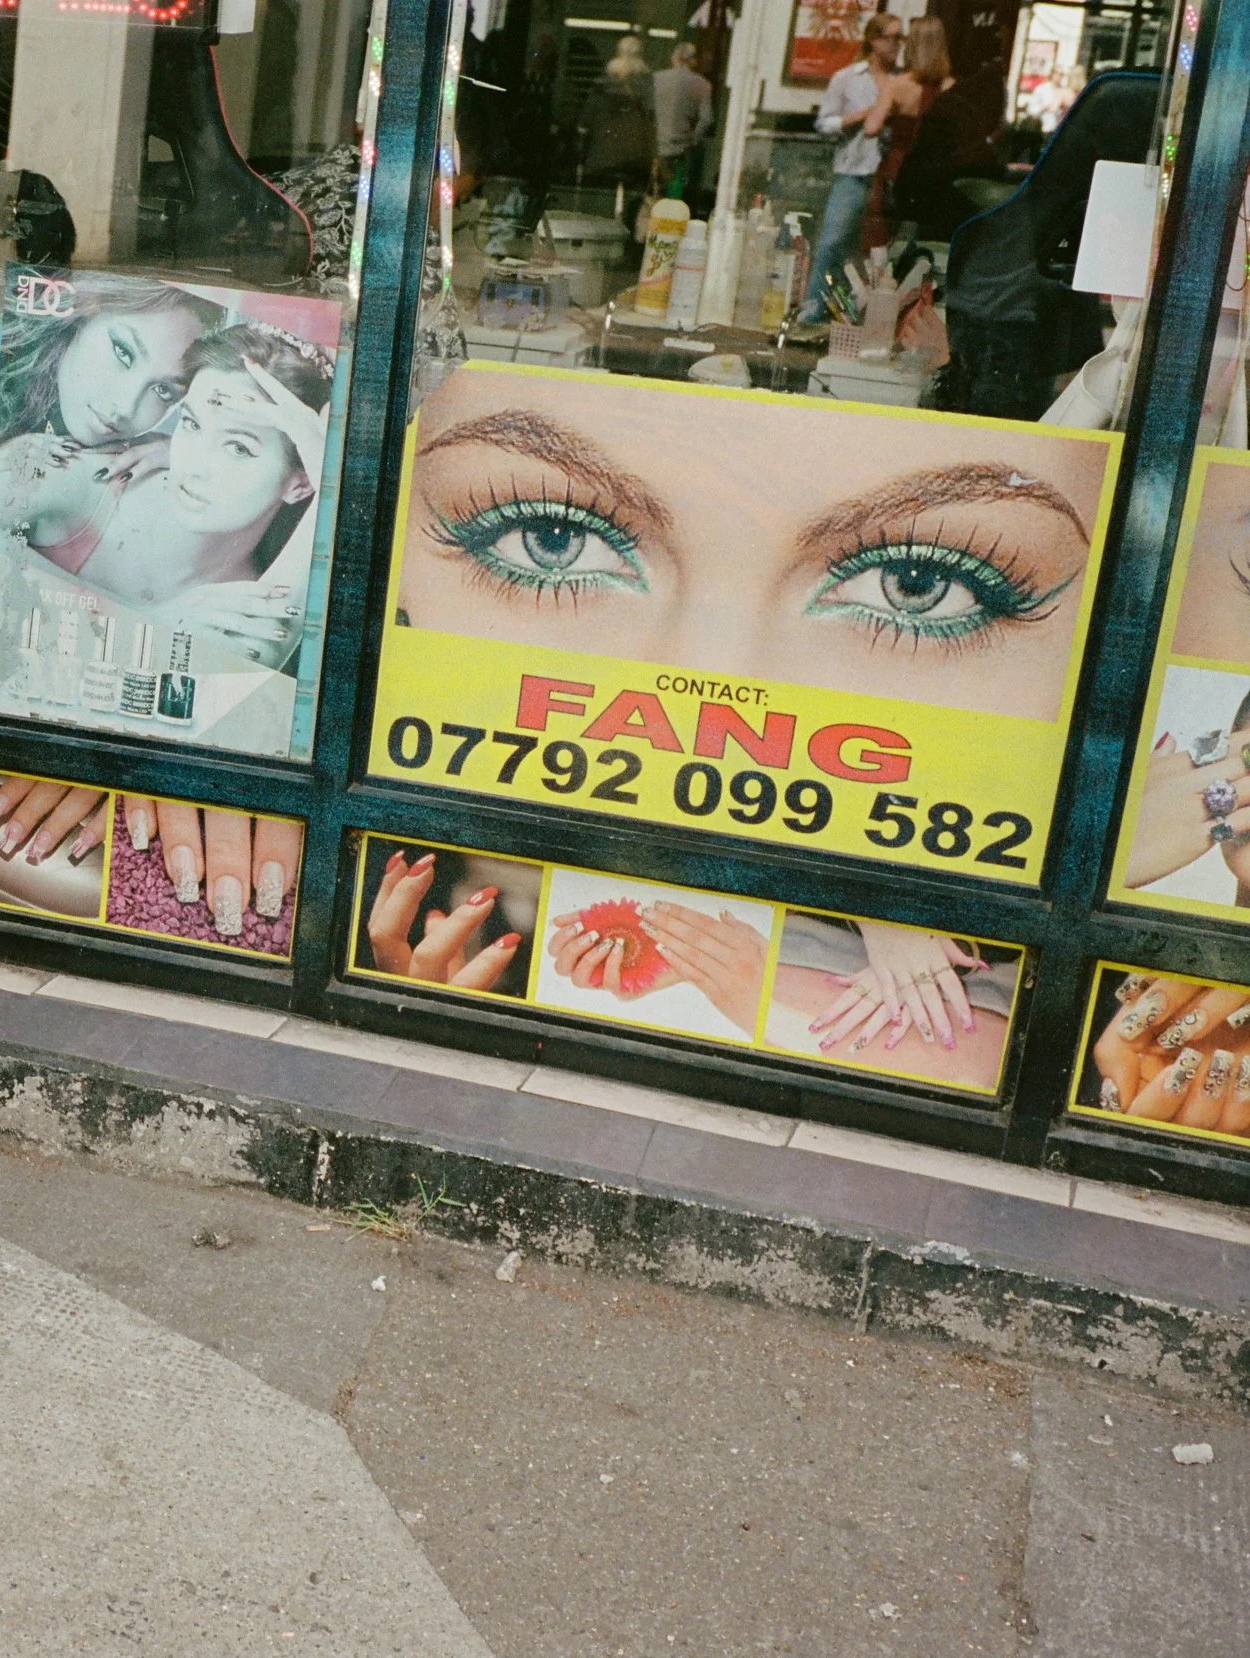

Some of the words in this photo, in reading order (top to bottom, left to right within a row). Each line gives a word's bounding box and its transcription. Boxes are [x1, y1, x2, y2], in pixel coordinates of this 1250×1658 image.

[54, 591, 76, 608] OFF
[78, 595, 100, 611] GEL
[655, 673, 770, 707] CONTACT:
[515, 673, 913, 785] FANG
[387, 715, 643, 805] 07792
[672, 761, 834, 834] 099
[863, 790, 1034, 870] 582
